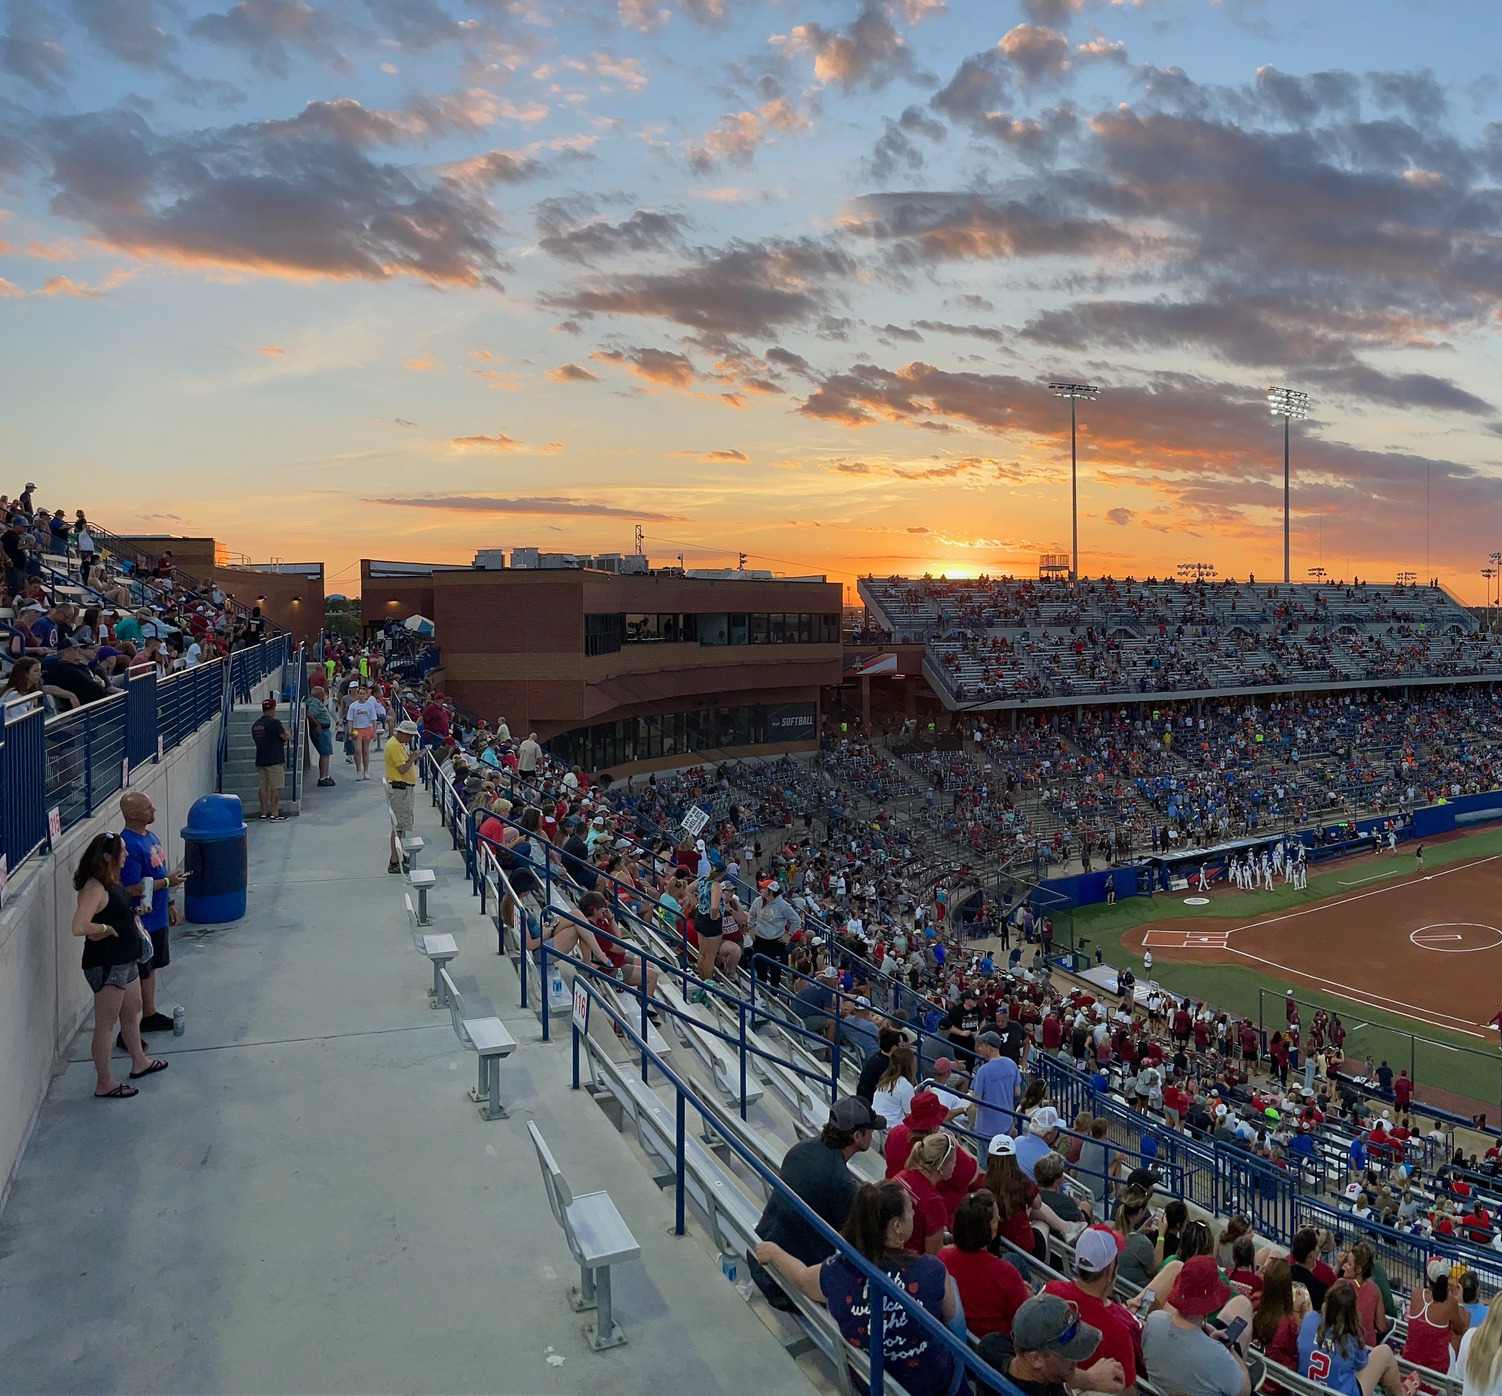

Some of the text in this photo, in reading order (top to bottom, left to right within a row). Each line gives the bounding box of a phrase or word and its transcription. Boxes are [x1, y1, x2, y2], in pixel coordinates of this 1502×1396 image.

[782, 716, 813, 727] SOFTBALL
[575, 990, 585, 1019] 116
[1308, 1350, 1331, 1386] 2
